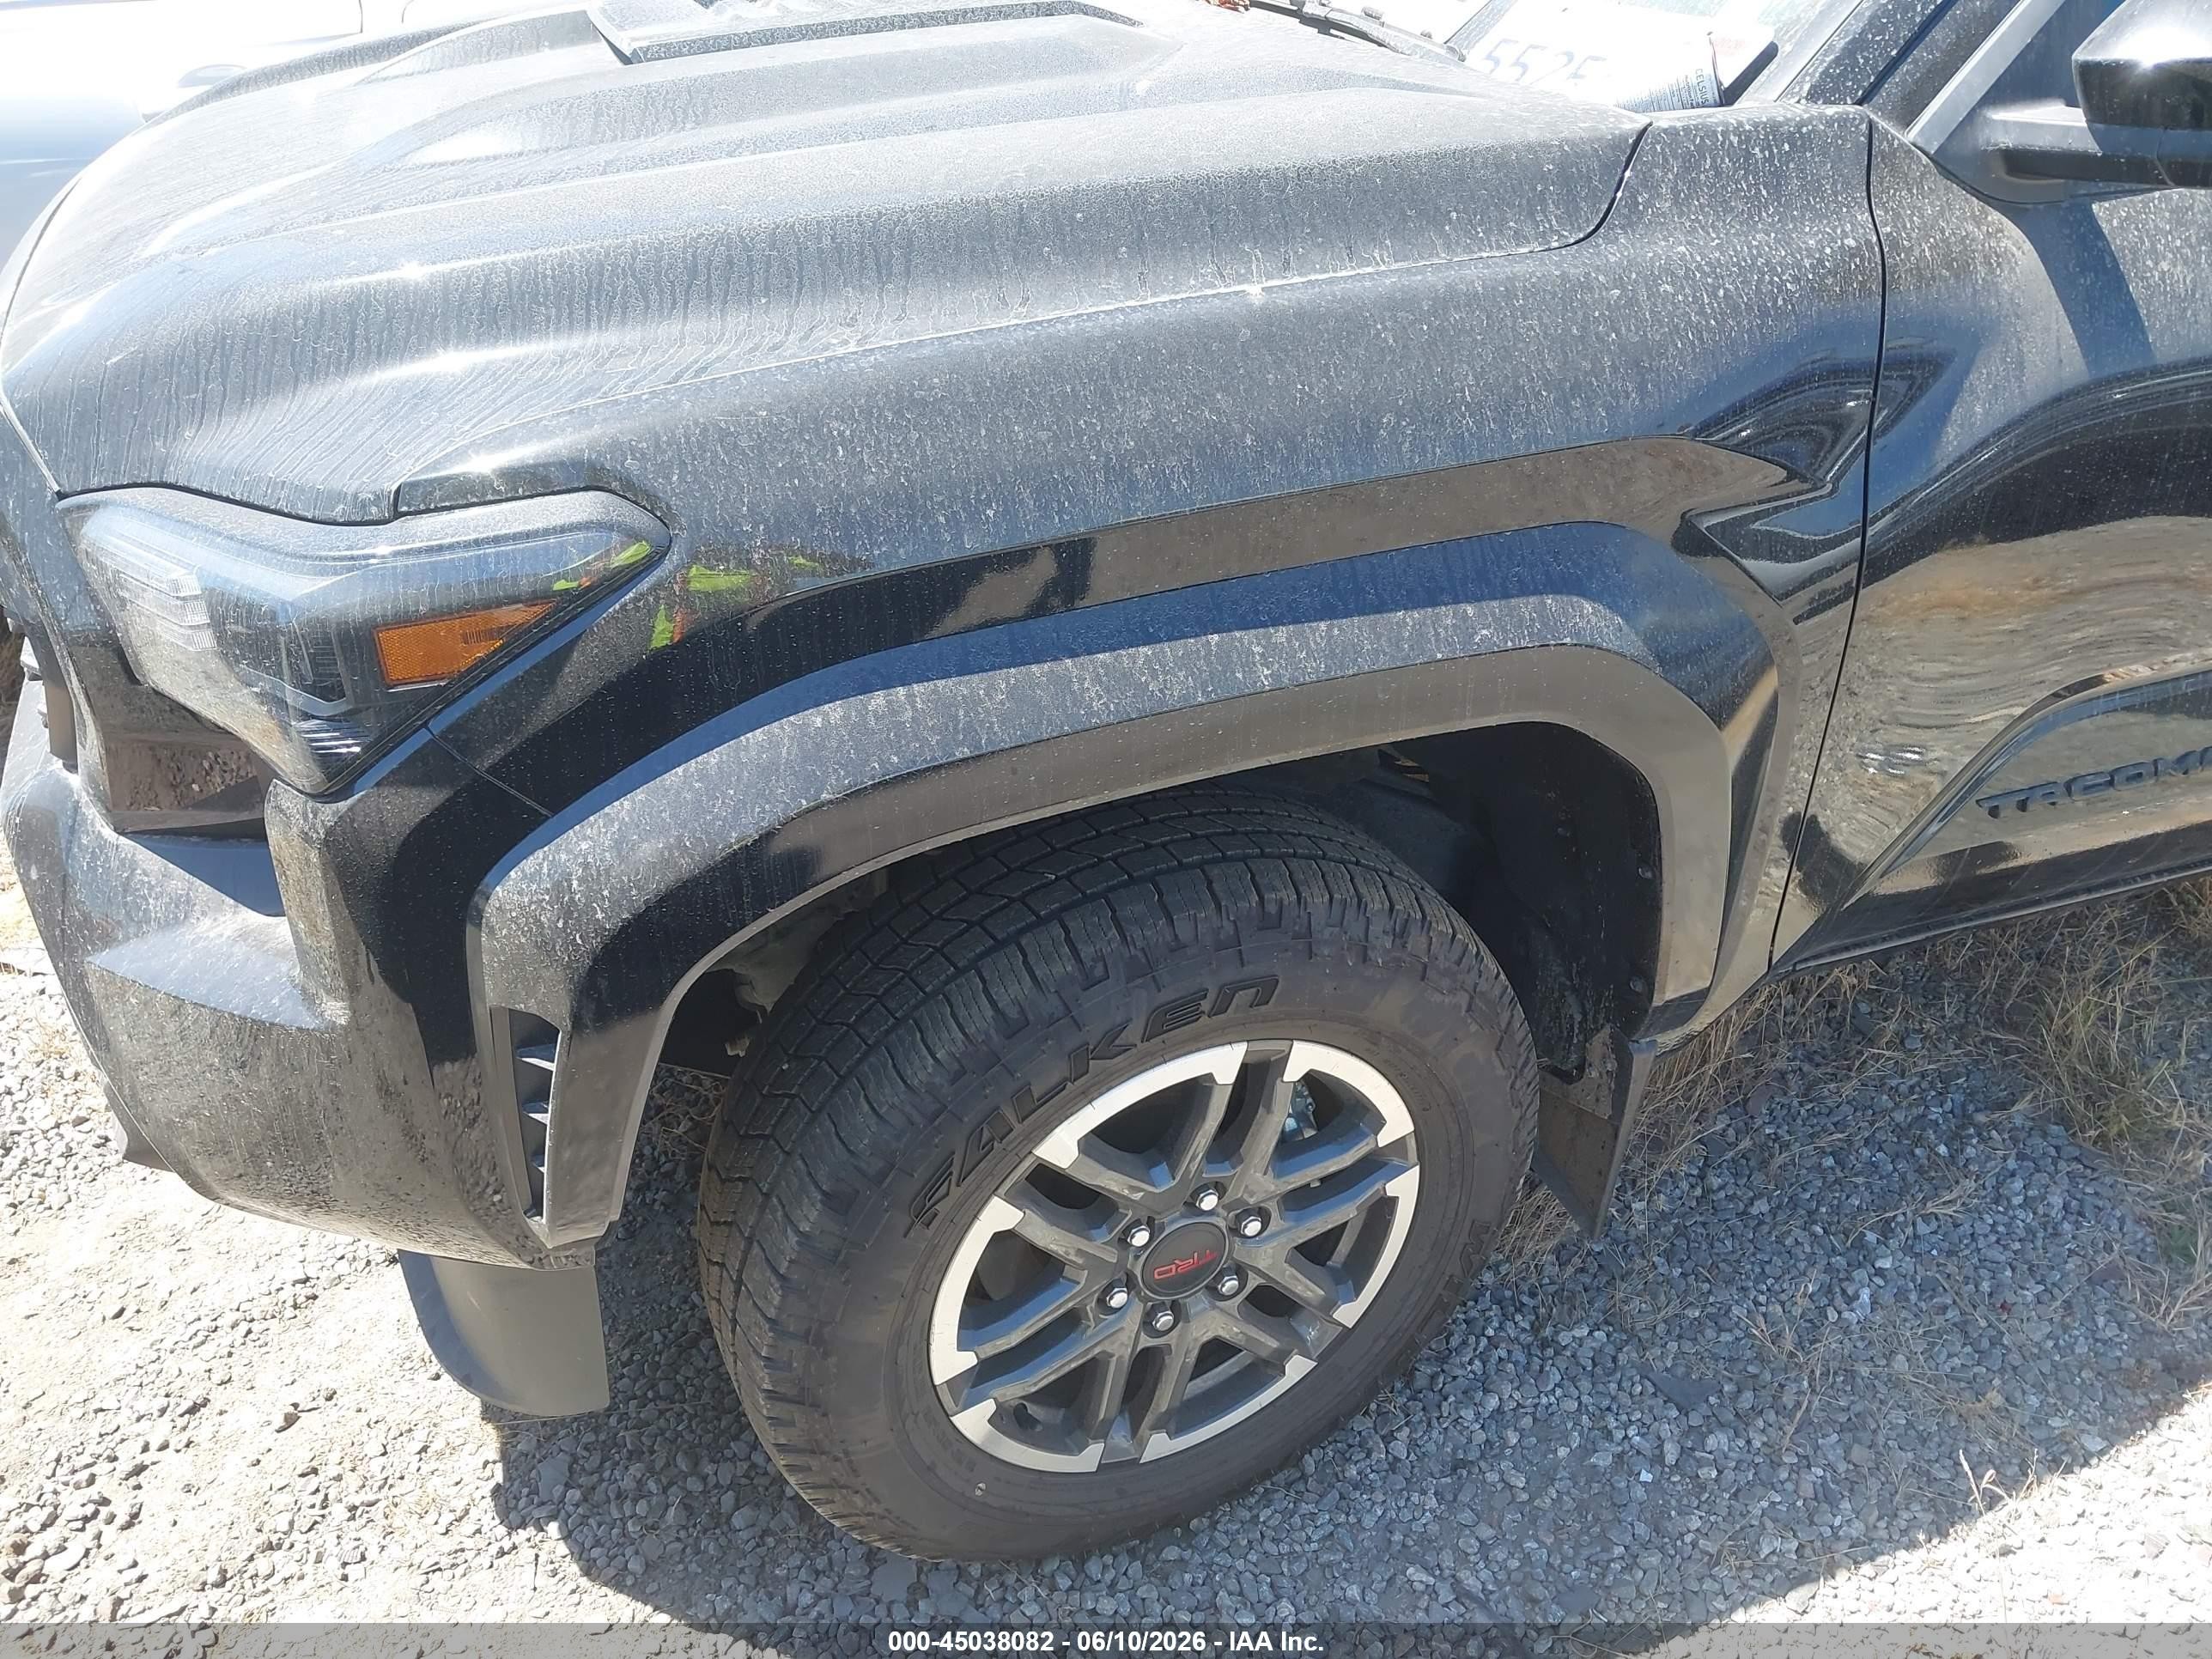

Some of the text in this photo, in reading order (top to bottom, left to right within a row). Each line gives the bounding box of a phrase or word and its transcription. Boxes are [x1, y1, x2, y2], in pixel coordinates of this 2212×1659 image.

[1695, 68, 1710, 105] CELSIUS
[1975, 744, 2212, 820] TACOM
[904, 975, 1279, 1238] FALKEN
[1153, 1249, 1218, 1280] TRD
